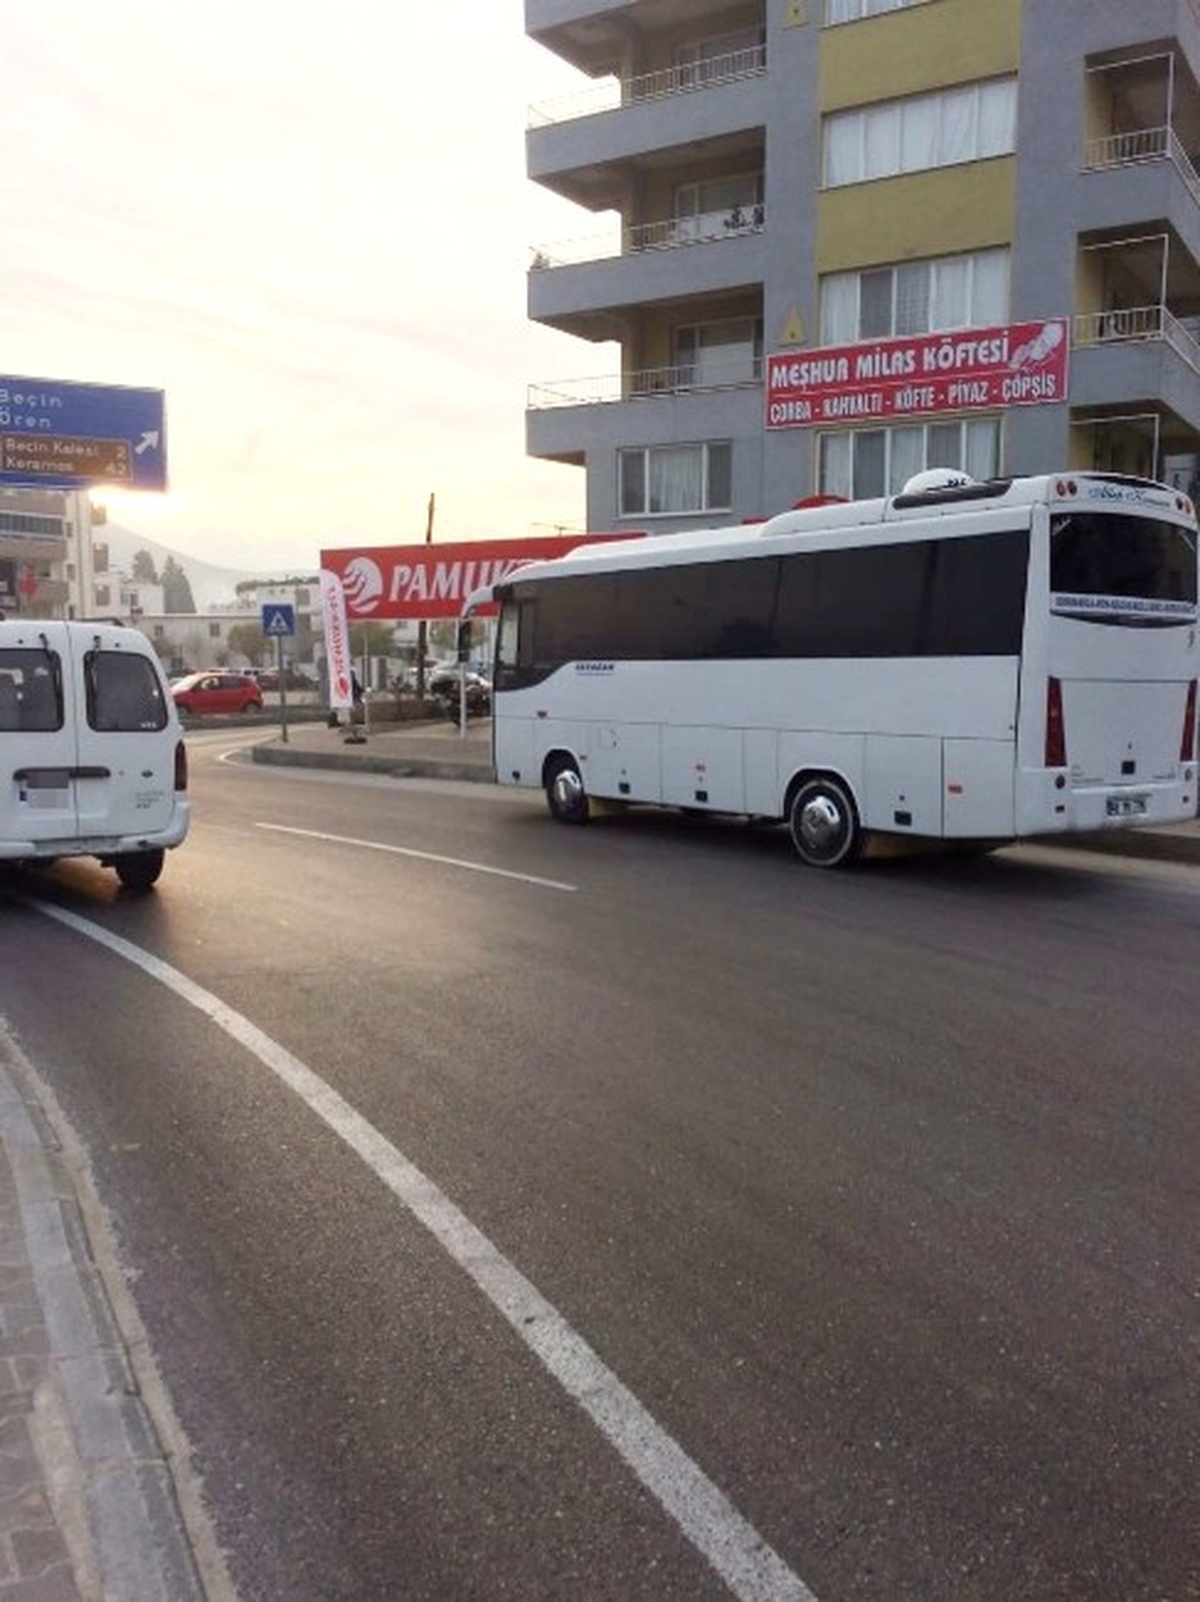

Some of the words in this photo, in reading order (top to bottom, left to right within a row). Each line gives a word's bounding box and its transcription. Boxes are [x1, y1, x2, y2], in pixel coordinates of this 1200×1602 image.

[771, 357, 849, 392] MEŞHUR
[855, 347, 916, 382] MİLAS
[922, 331, 1009, 371] KÖFTESİ
[895, 386, 935, 410] KÖFTE
[948, 380, 989, 403] PİYAZ
[388, 558, 536, 602] PAMUK
